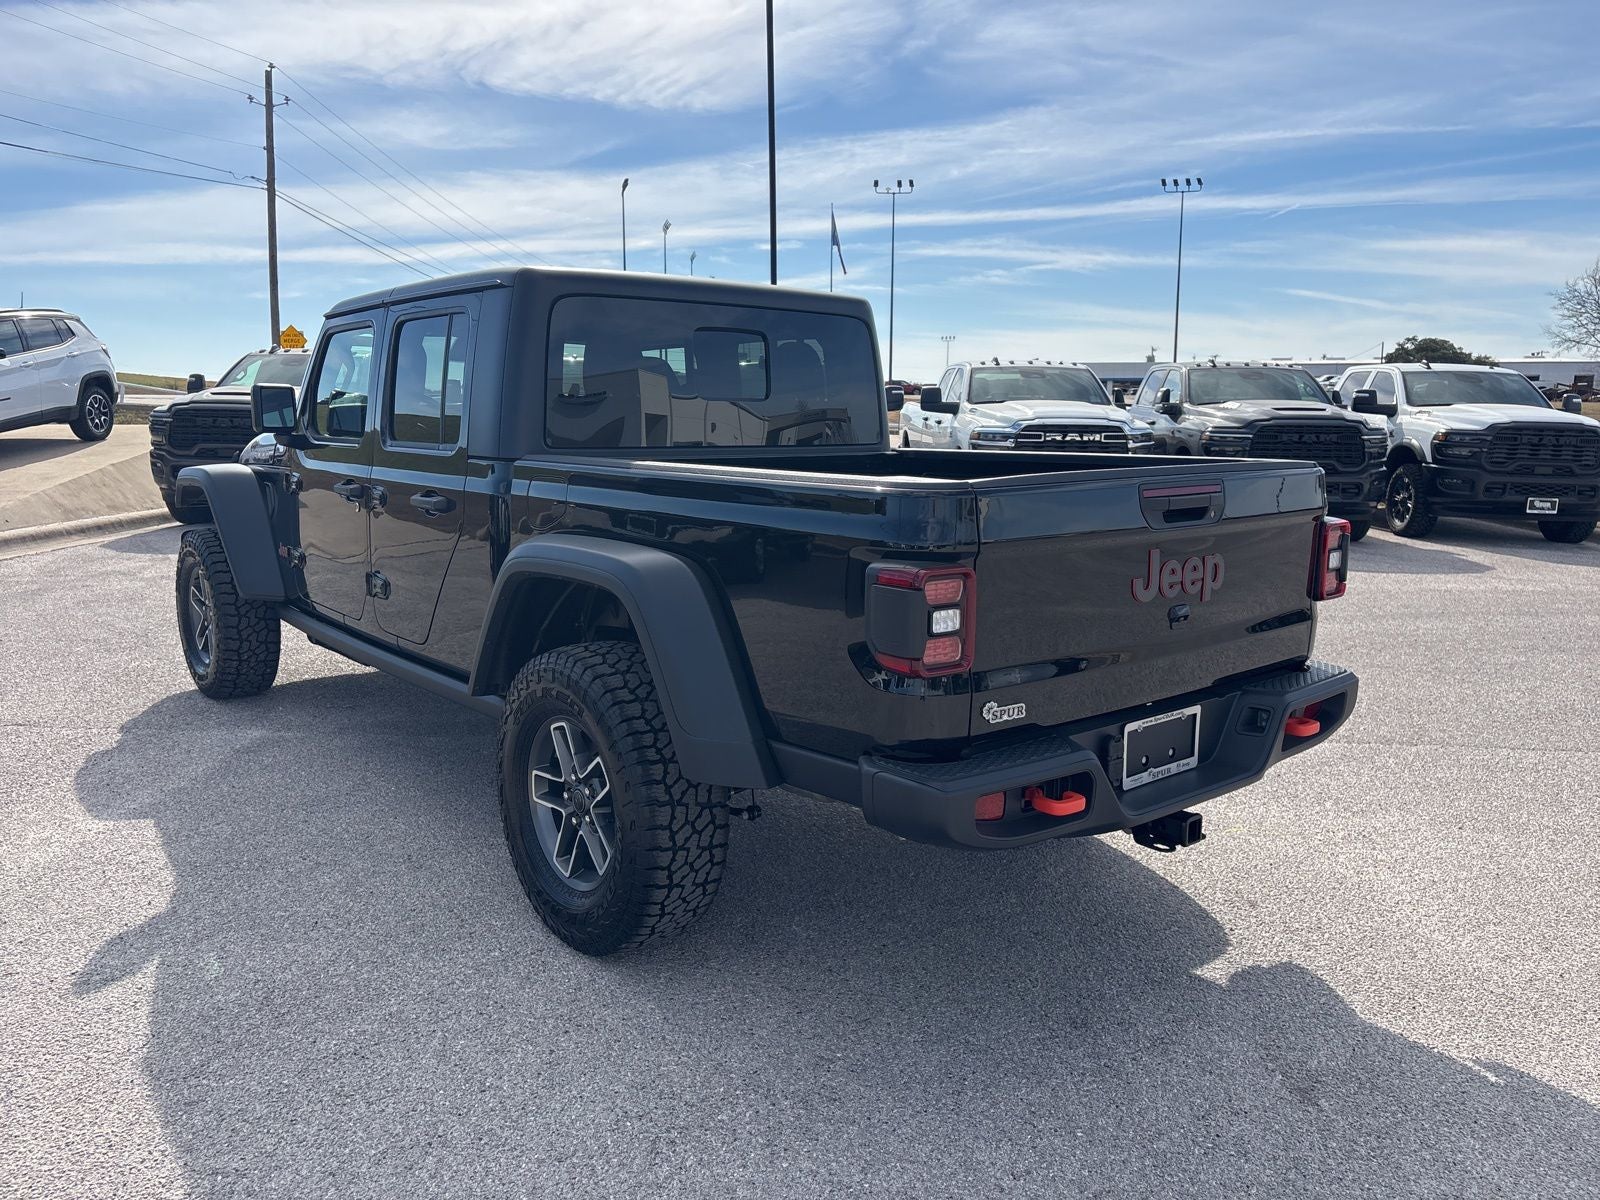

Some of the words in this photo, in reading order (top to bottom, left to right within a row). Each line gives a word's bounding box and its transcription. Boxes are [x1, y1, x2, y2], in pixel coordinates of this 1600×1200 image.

[1045, 432, 1100, 441] RAM
[1131, 548, 1225, 603] Jeep
[991, 705, 1024, 720] SPUR
[1151, 767, 1172, 780] SPUR
